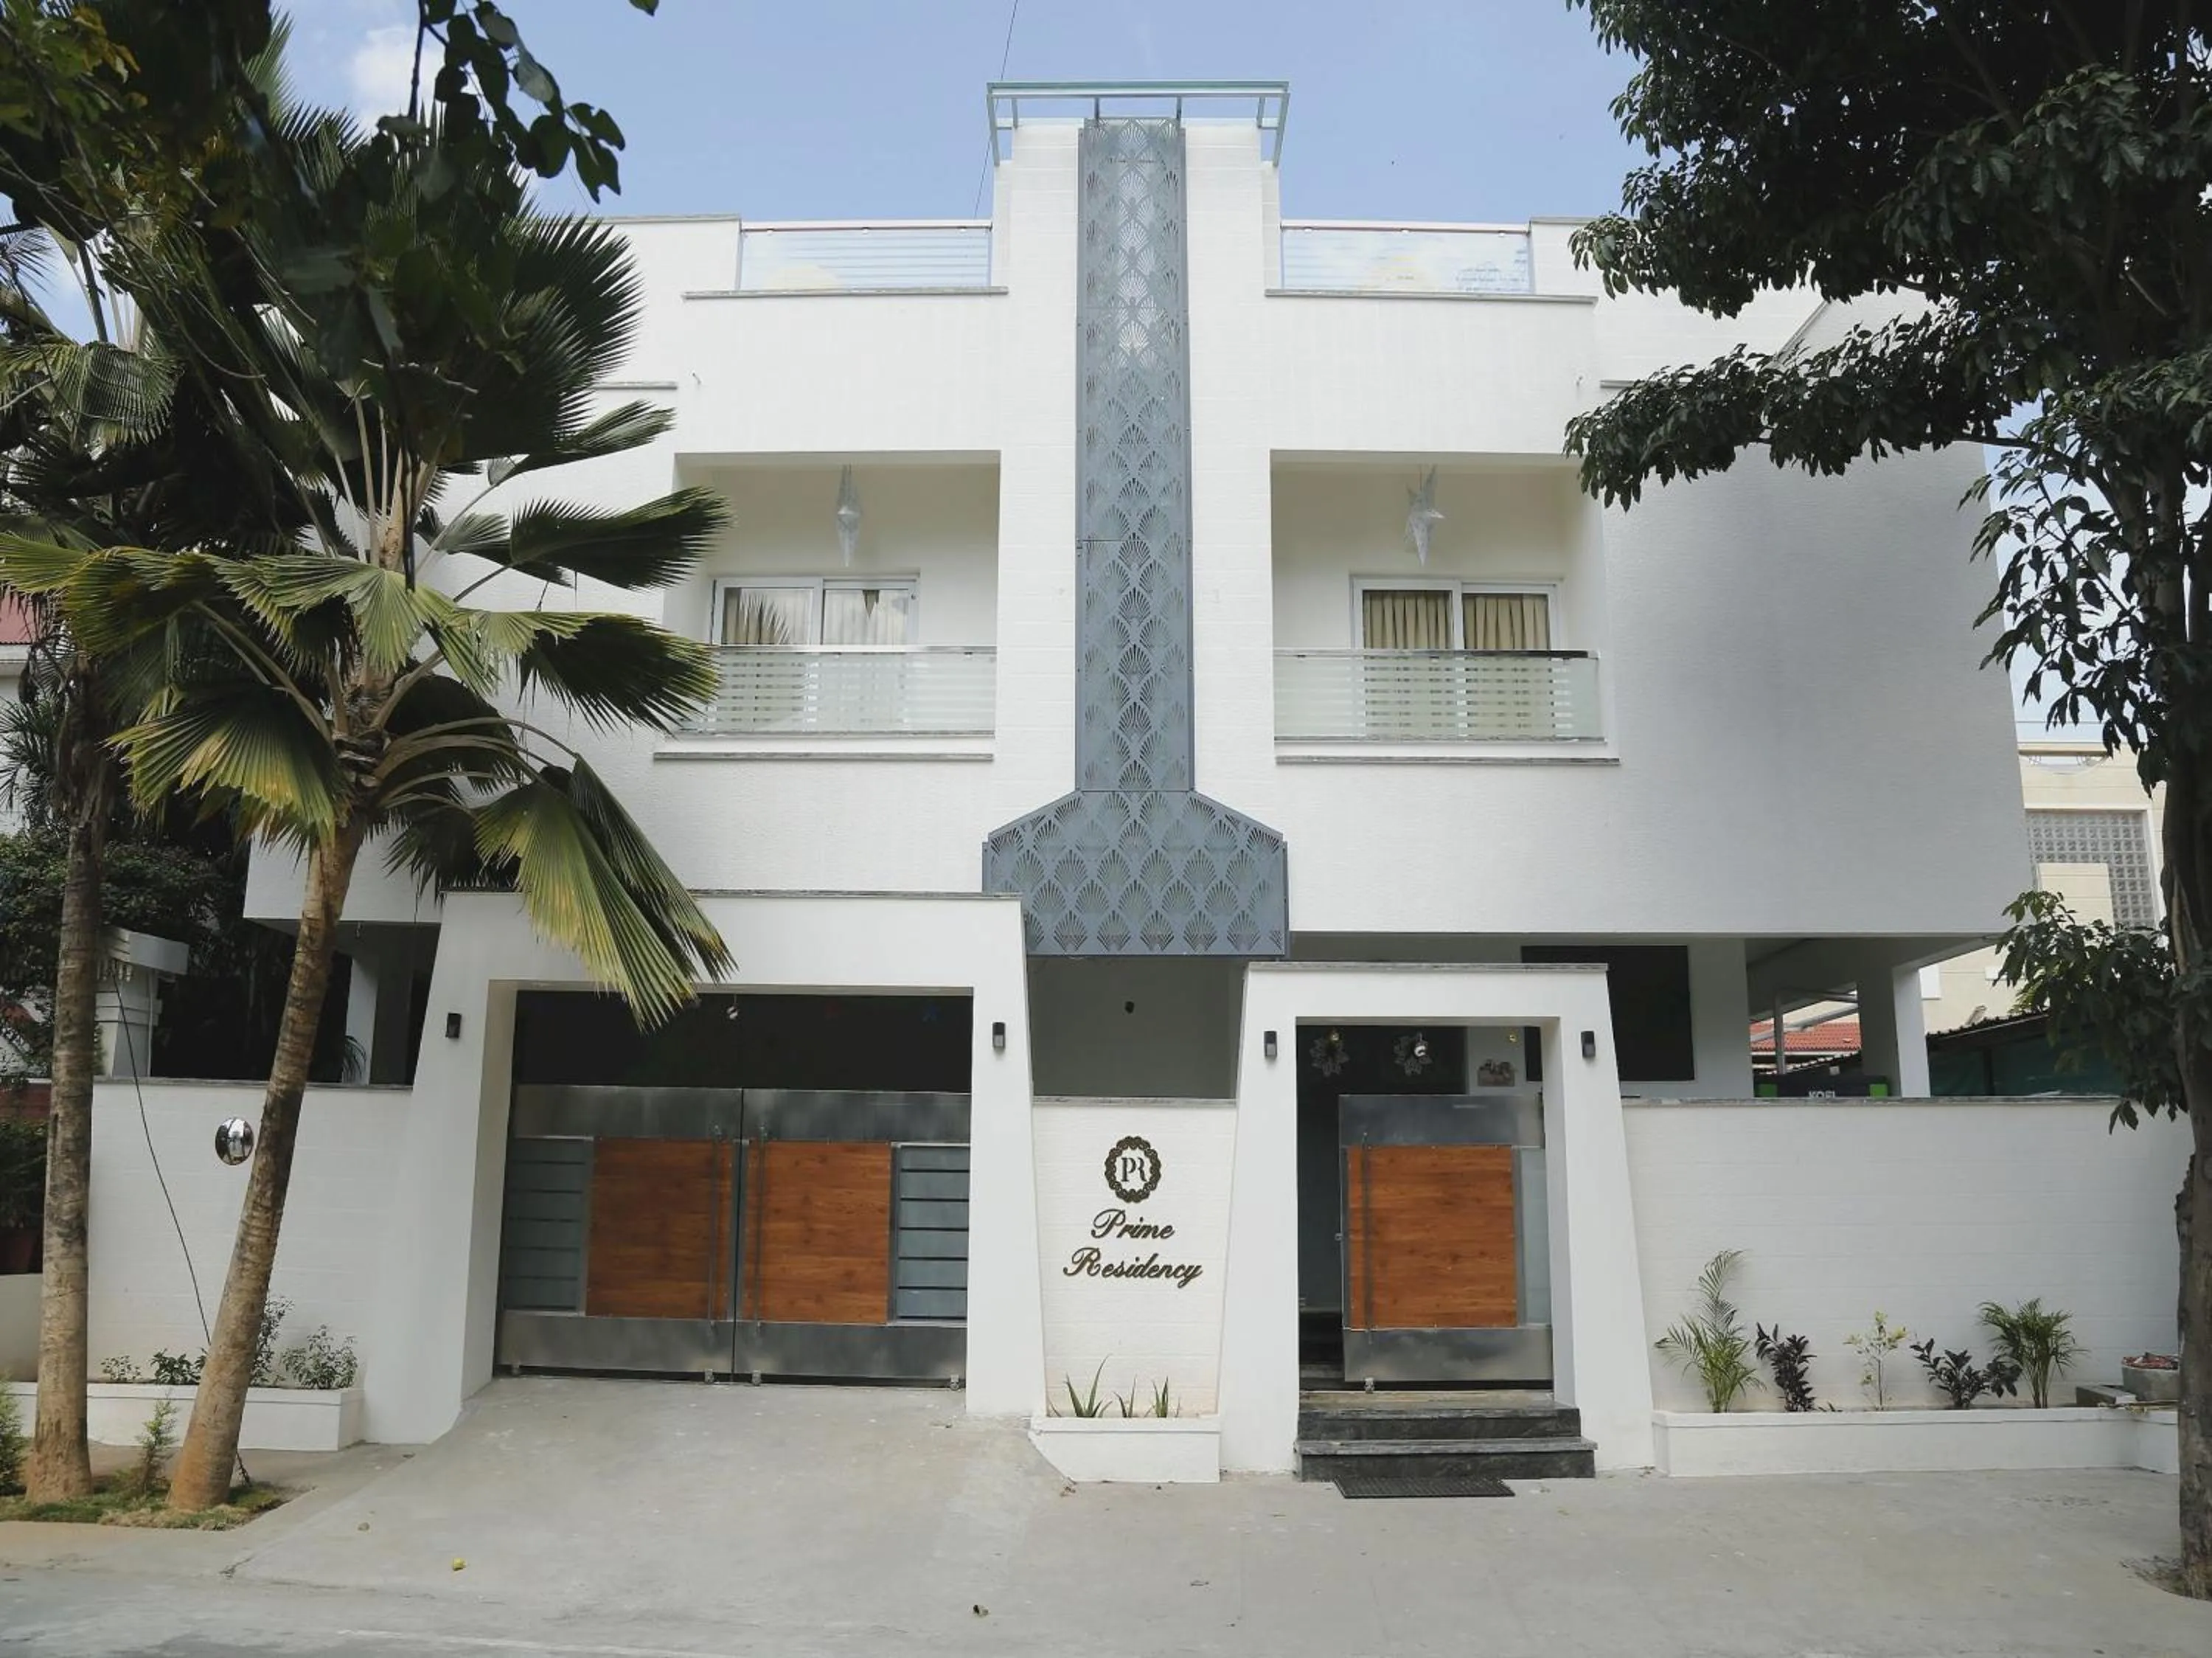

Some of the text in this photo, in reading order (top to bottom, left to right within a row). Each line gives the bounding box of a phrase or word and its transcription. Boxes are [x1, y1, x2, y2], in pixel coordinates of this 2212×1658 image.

[1120, 1156, 1148, 1182] PR
[1091, 1208, 1175, 1240] Prime
[1062, 1246, 1203, 1289] Residency
